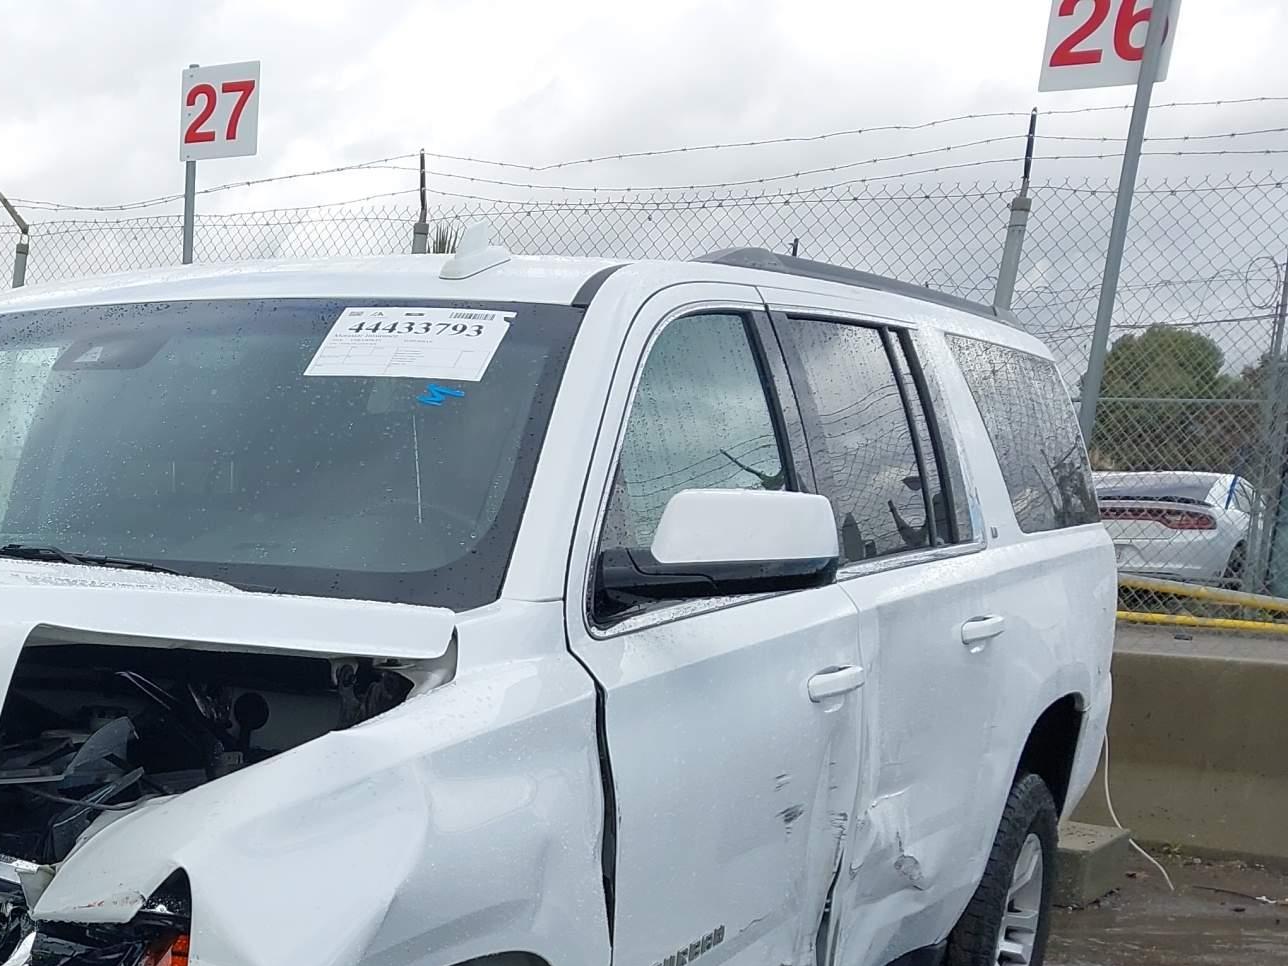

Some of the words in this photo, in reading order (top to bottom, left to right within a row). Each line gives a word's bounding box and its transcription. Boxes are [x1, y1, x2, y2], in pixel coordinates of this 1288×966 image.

[1049, 0, 1169, 67] 26
[184, 80, 255, 144] 27
[348, 321, 484, 337] 44433793
